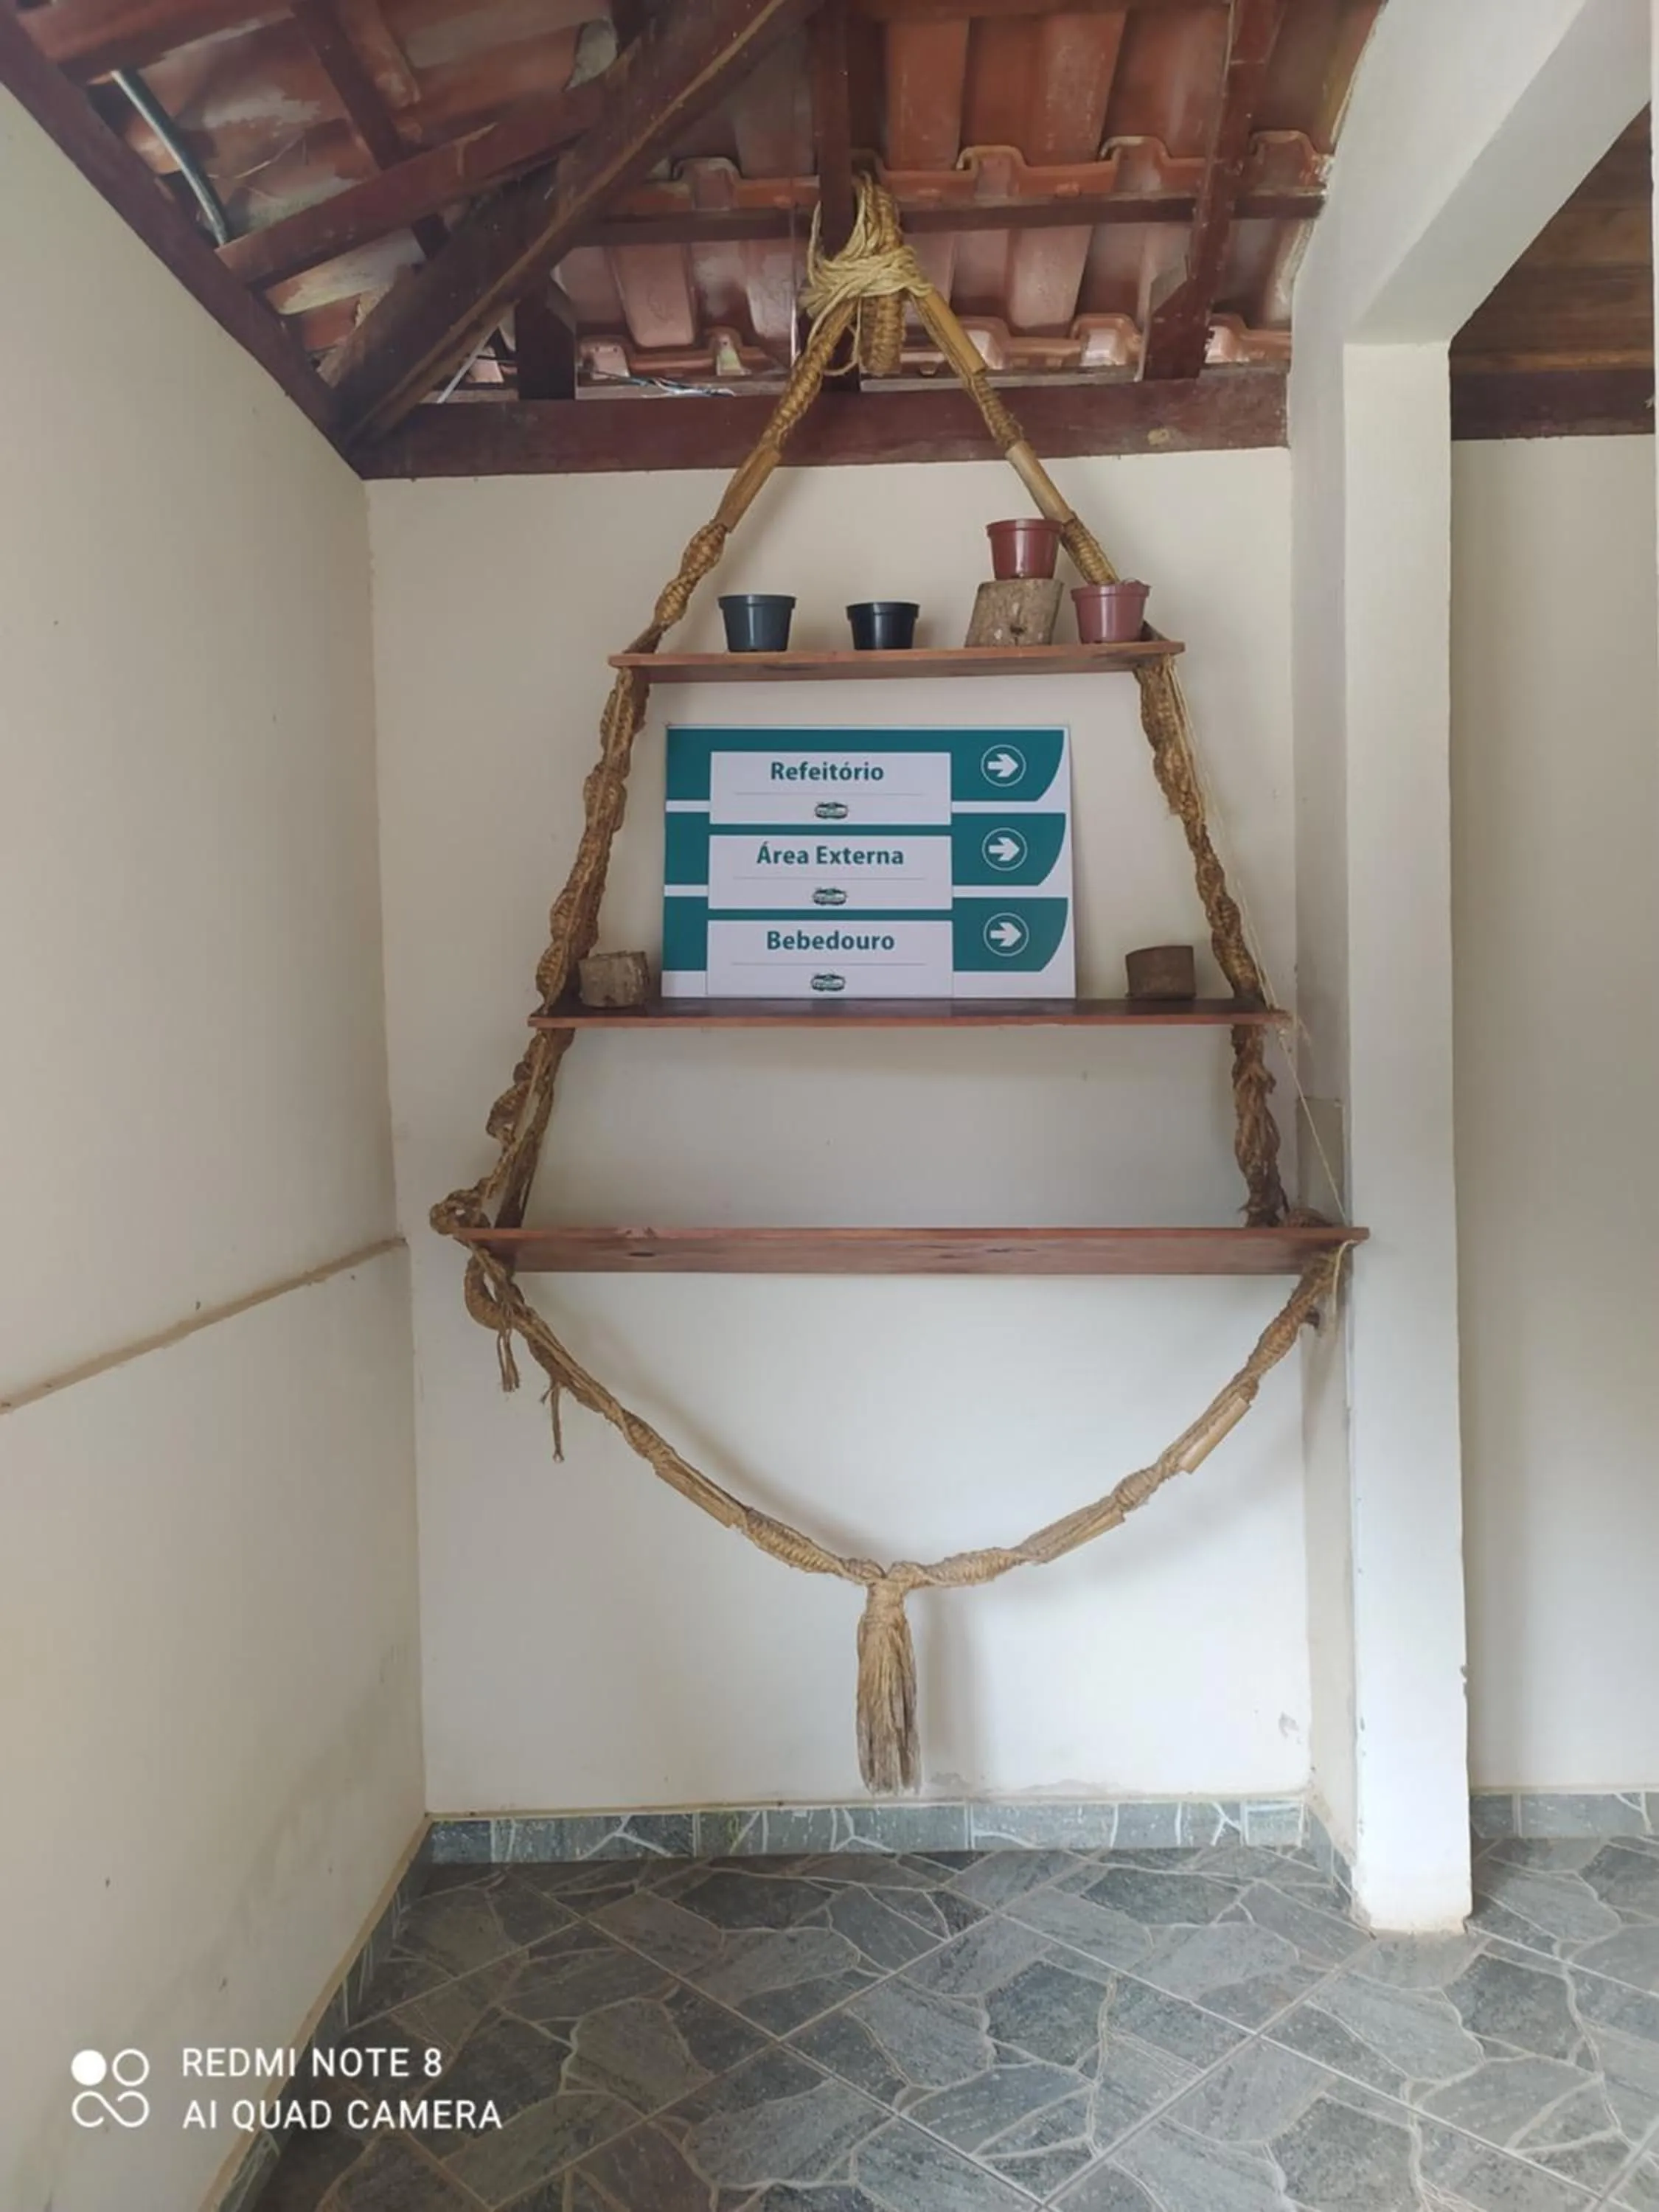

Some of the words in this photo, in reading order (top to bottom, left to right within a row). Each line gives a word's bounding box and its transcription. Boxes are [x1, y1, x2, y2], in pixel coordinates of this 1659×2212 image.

[771, 761, 884, 781] Refeitório
[757, 841, 810, 865] Área
[816, 846, 904, 865] Externa
[767, 931, 894, 950] Bebedouro
